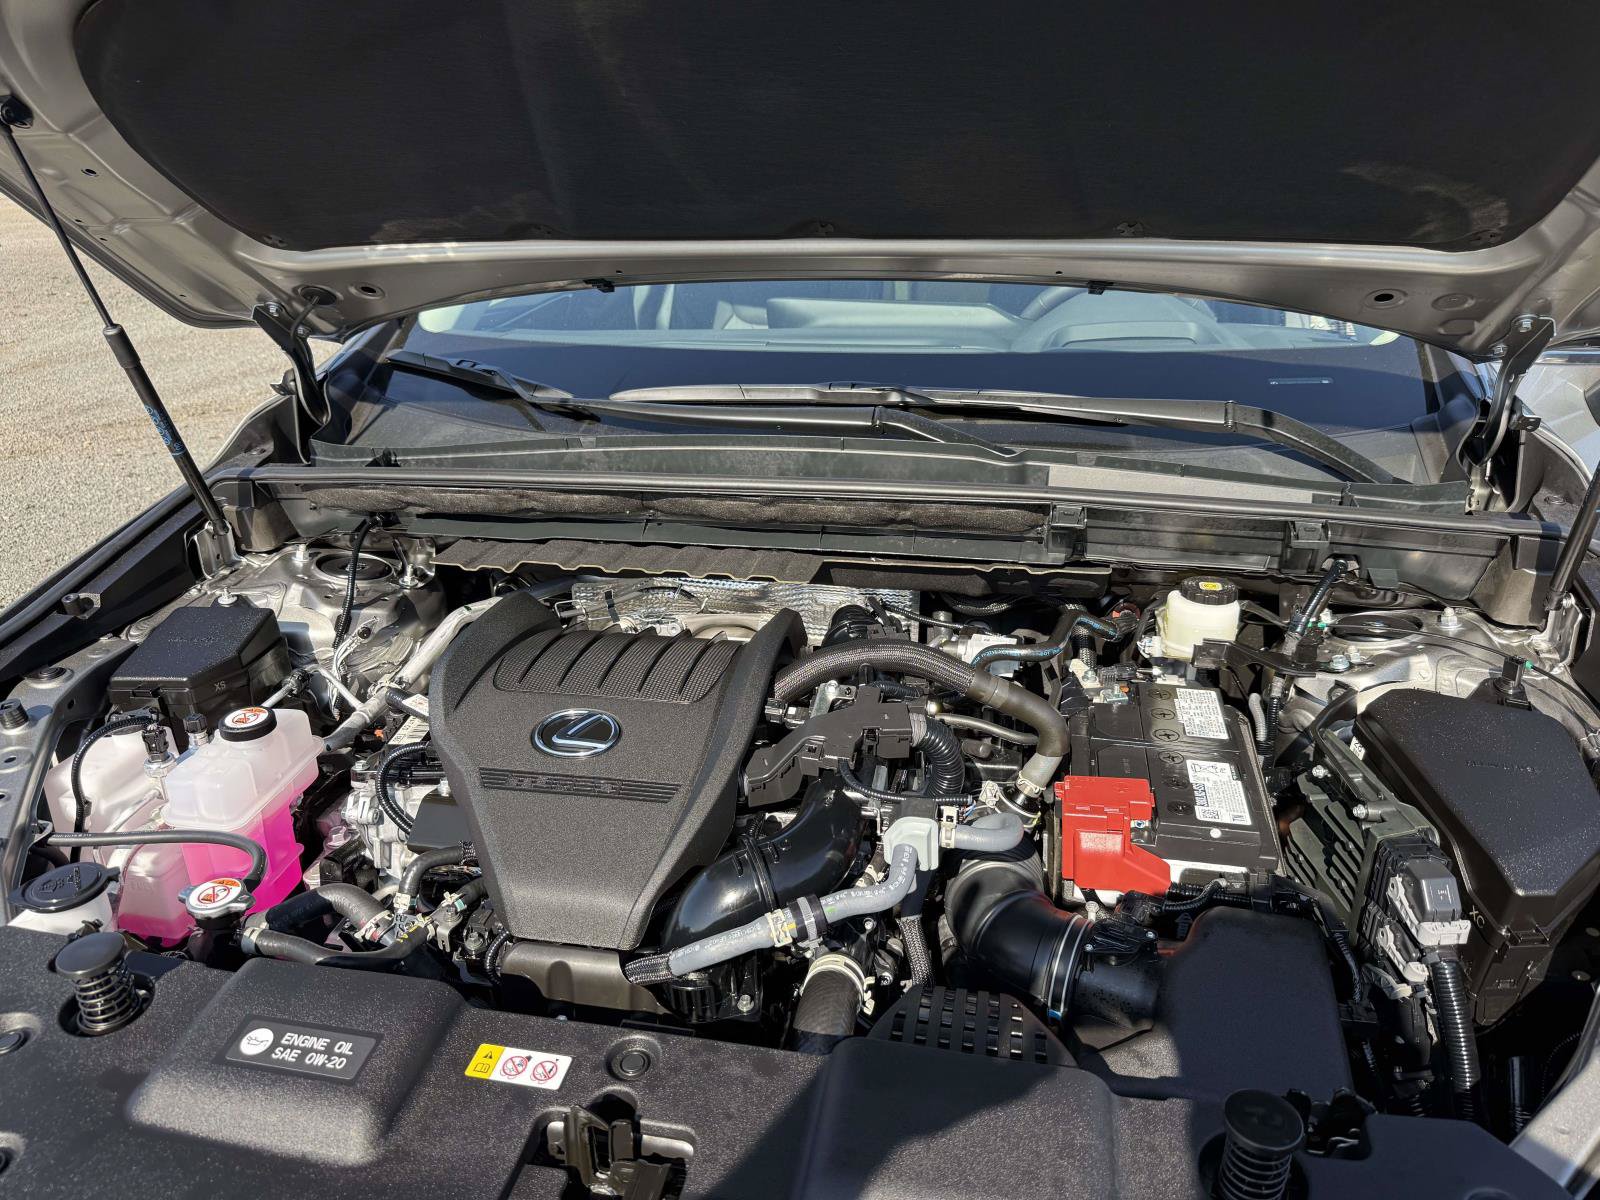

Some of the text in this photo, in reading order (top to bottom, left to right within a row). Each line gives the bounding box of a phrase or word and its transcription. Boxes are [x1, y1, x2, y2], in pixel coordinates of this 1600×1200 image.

[280, 1032, 353, 1055] ENGINE OIL
[271, 1046, 347, 1069] SAE 0W-20
